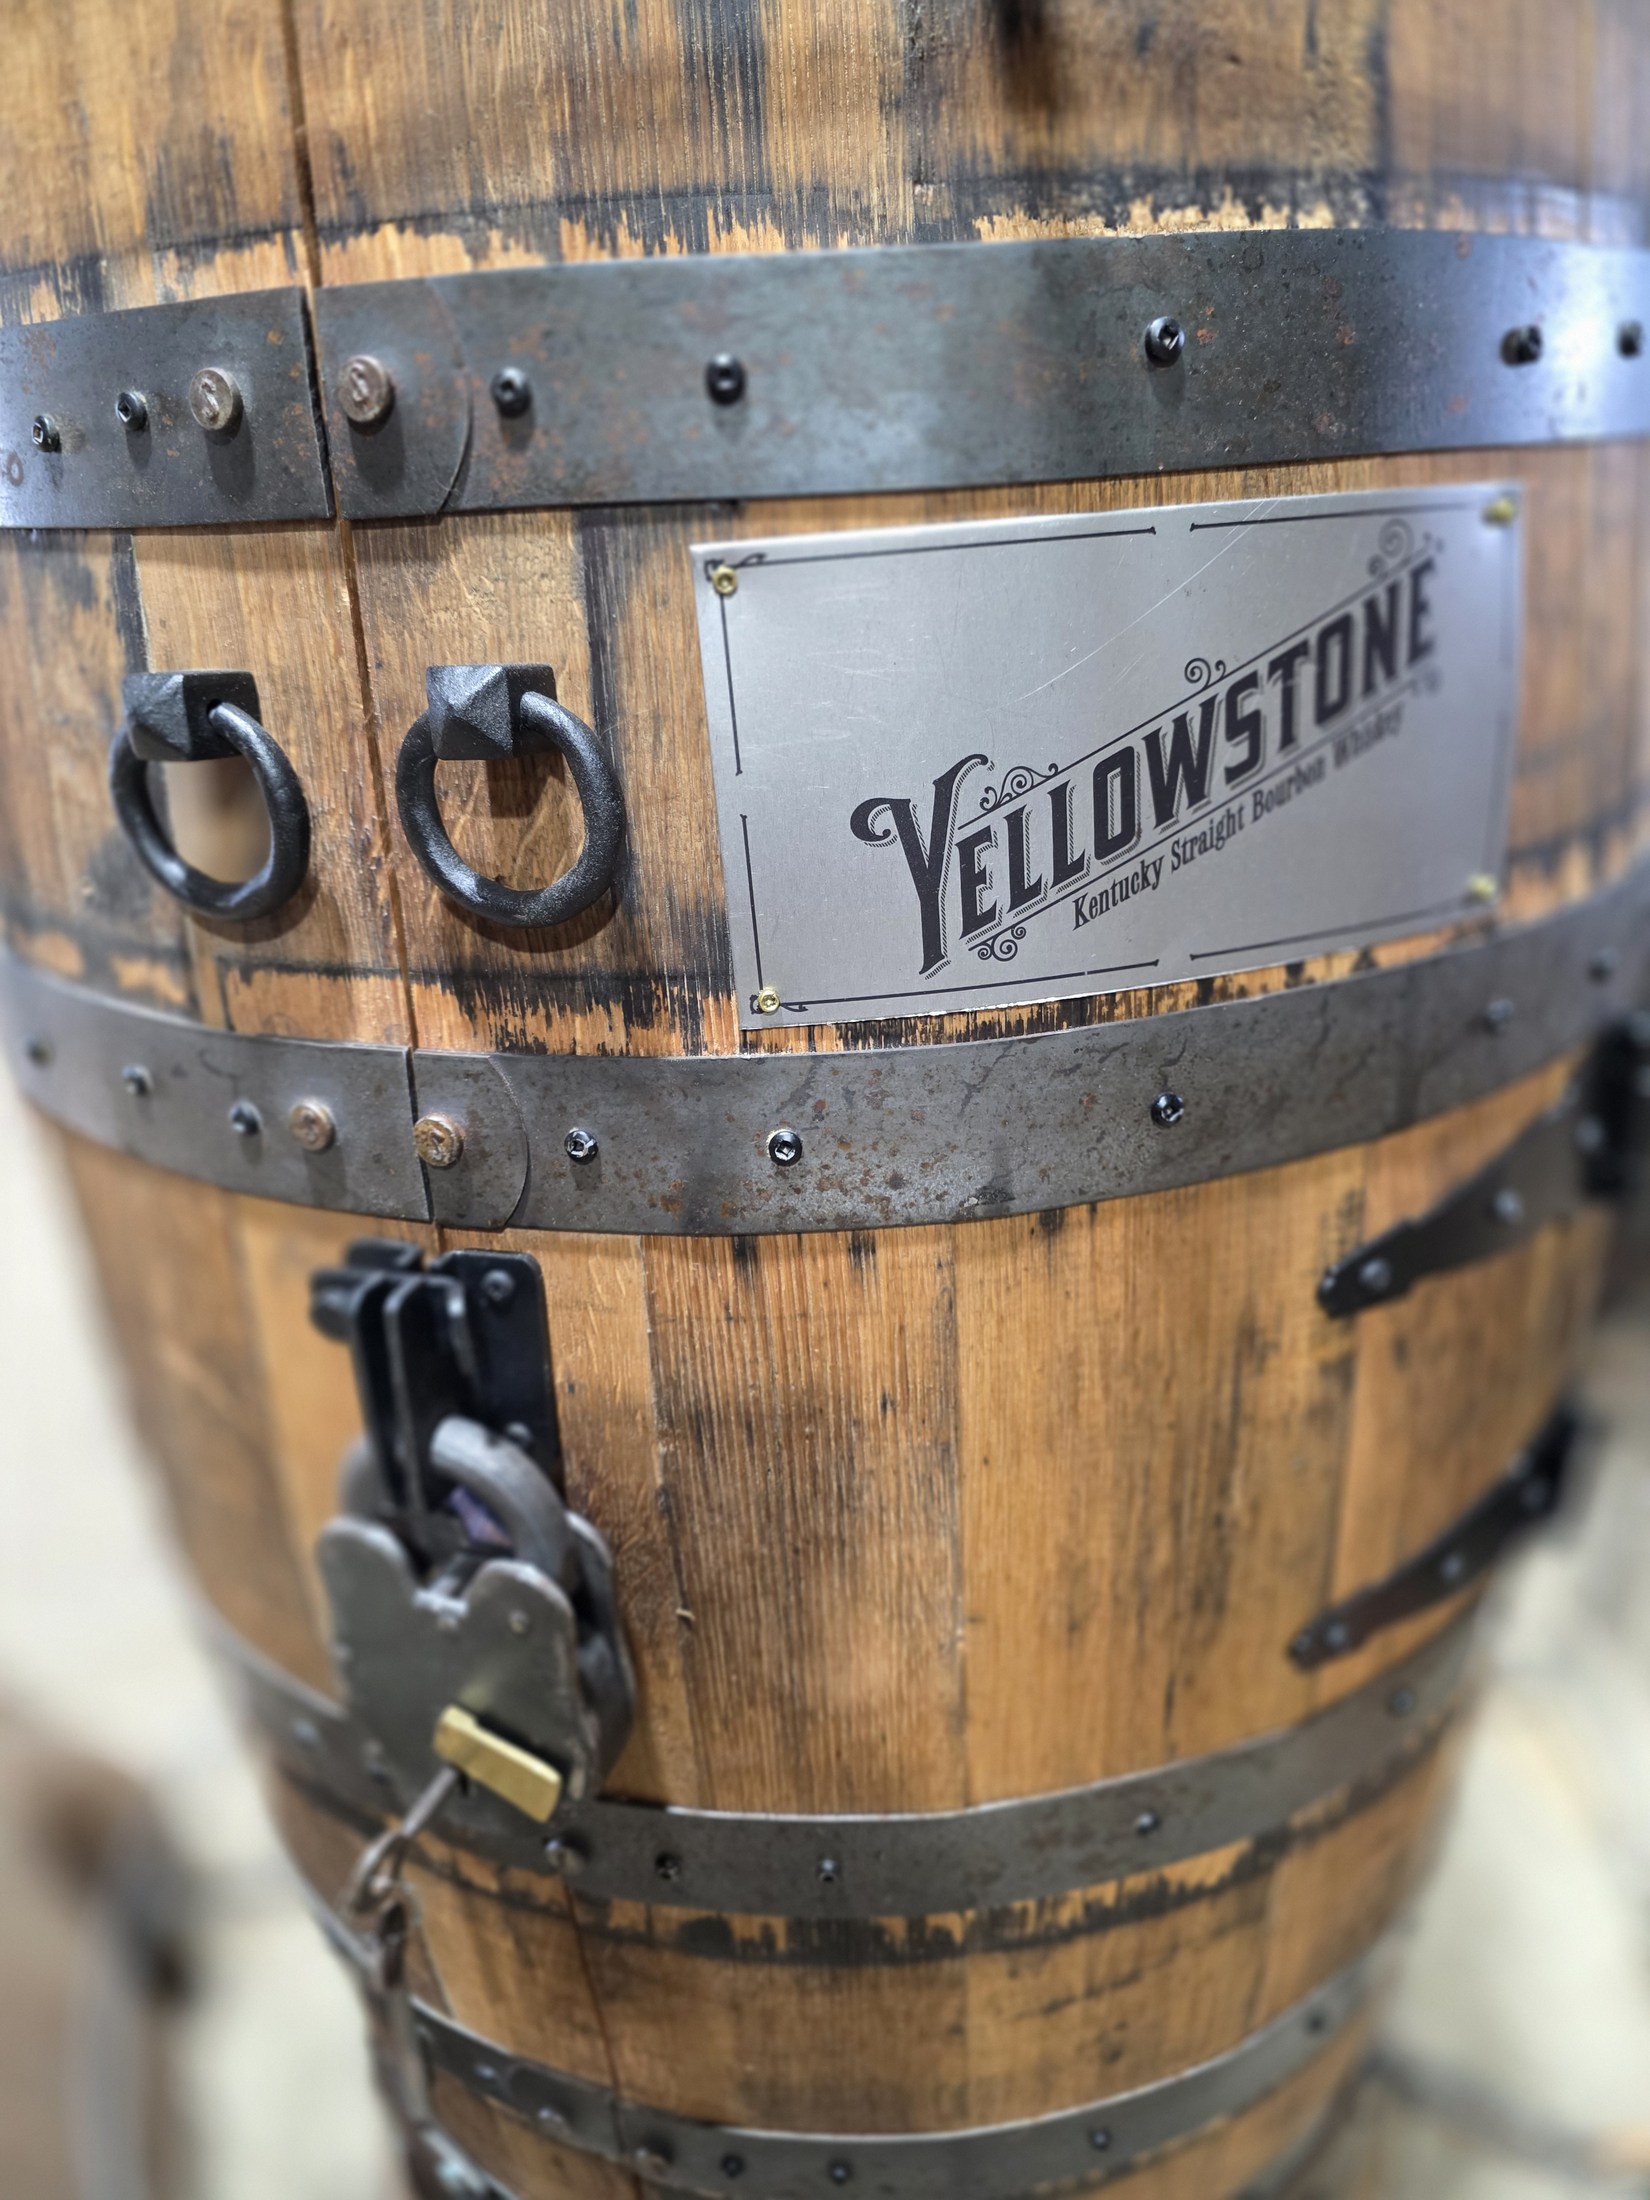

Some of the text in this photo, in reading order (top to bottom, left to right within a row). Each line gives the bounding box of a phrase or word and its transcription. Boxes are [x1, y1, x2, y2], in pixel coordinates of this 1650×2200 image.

[849, 556, 1437, 977] YELLOWSTONE
[1072, 854, 1165, 931] Kentucky
[1170, 804, 1246, 873] Straight
[1251, 755, 1326, 824] Bourbon
